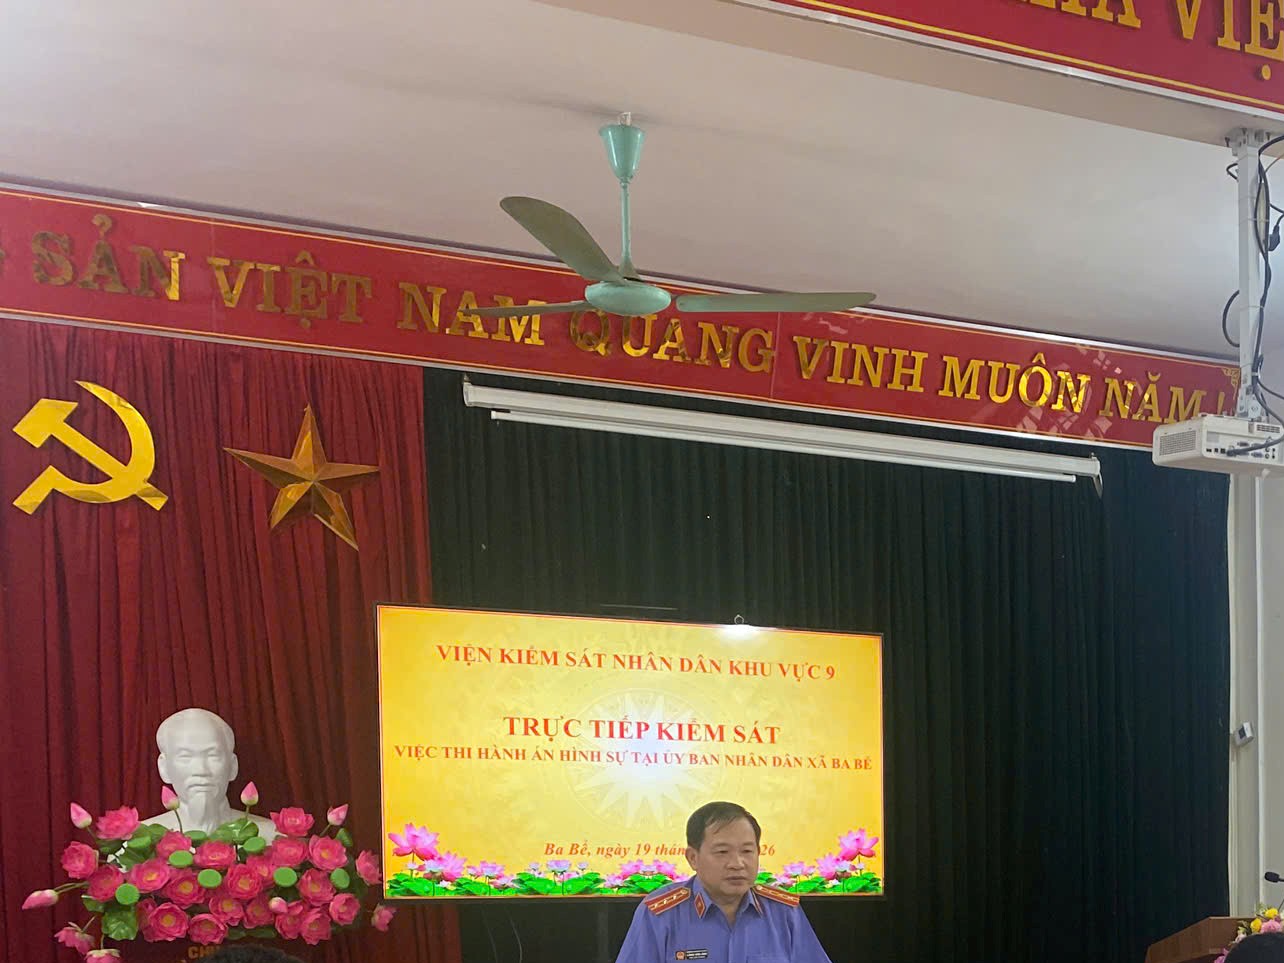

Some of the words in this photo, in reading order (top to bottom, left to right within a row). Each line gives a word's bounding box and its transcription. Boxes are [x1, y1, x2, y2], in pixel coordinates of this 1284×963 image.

[31, 213, 187, 300] SẢN
[206, 250, 373, 329] VIỆT
[397, 281, 546, 346] NAM
[569, 309, 776, 373] QUANG
[792, 335, 929, 394] VINH
[938, 352, 1091, 413] MUÔN
[1101, 371, 1207, 424] NĂM
[436, 643, 492, 666] VIỆN
[500, 645, 559, 667] KIỂM
[565, 648, 607, 668] SÁT
[613, 651, 673, 672] NHÂN
[679, 654, 722, 674] DÂN
[729, 660, 772, 677] KHU
[778, 662, 822, 682] VỰC
[826, 665, 836, 680] 9
[503, 716, 582, 742] TRỰC
[589, 715, 650, 740] TIẾP
[657, 717, 725, 742] KIỂM
[733, 720, 781, 744] SÁT
[394, 744, 438, 761] VIỆC
[441, 746, 472, 759] THI
[478, 744, 526, 761] HÀNH
[531, 745, 554, 761] ÁN
[559, 746, 601, 762] HÌNH
[606, 749, 628, 766] SỰ
[631, 751, 658, 767] TẠI
[689, 753, 720, 766] BAN
[724, 752, 768, 768] NHÂN
[772, 754, 802, 768] DÂN
[806, 755, 828, 769] XÃ
[831, 758, 851, 770] BA
[544, 843, 564, 856] Ba
[596, 844, 631, 858] ngày
[636, 843, 651, 856] 19
[655, 842, 686, 856] thán
